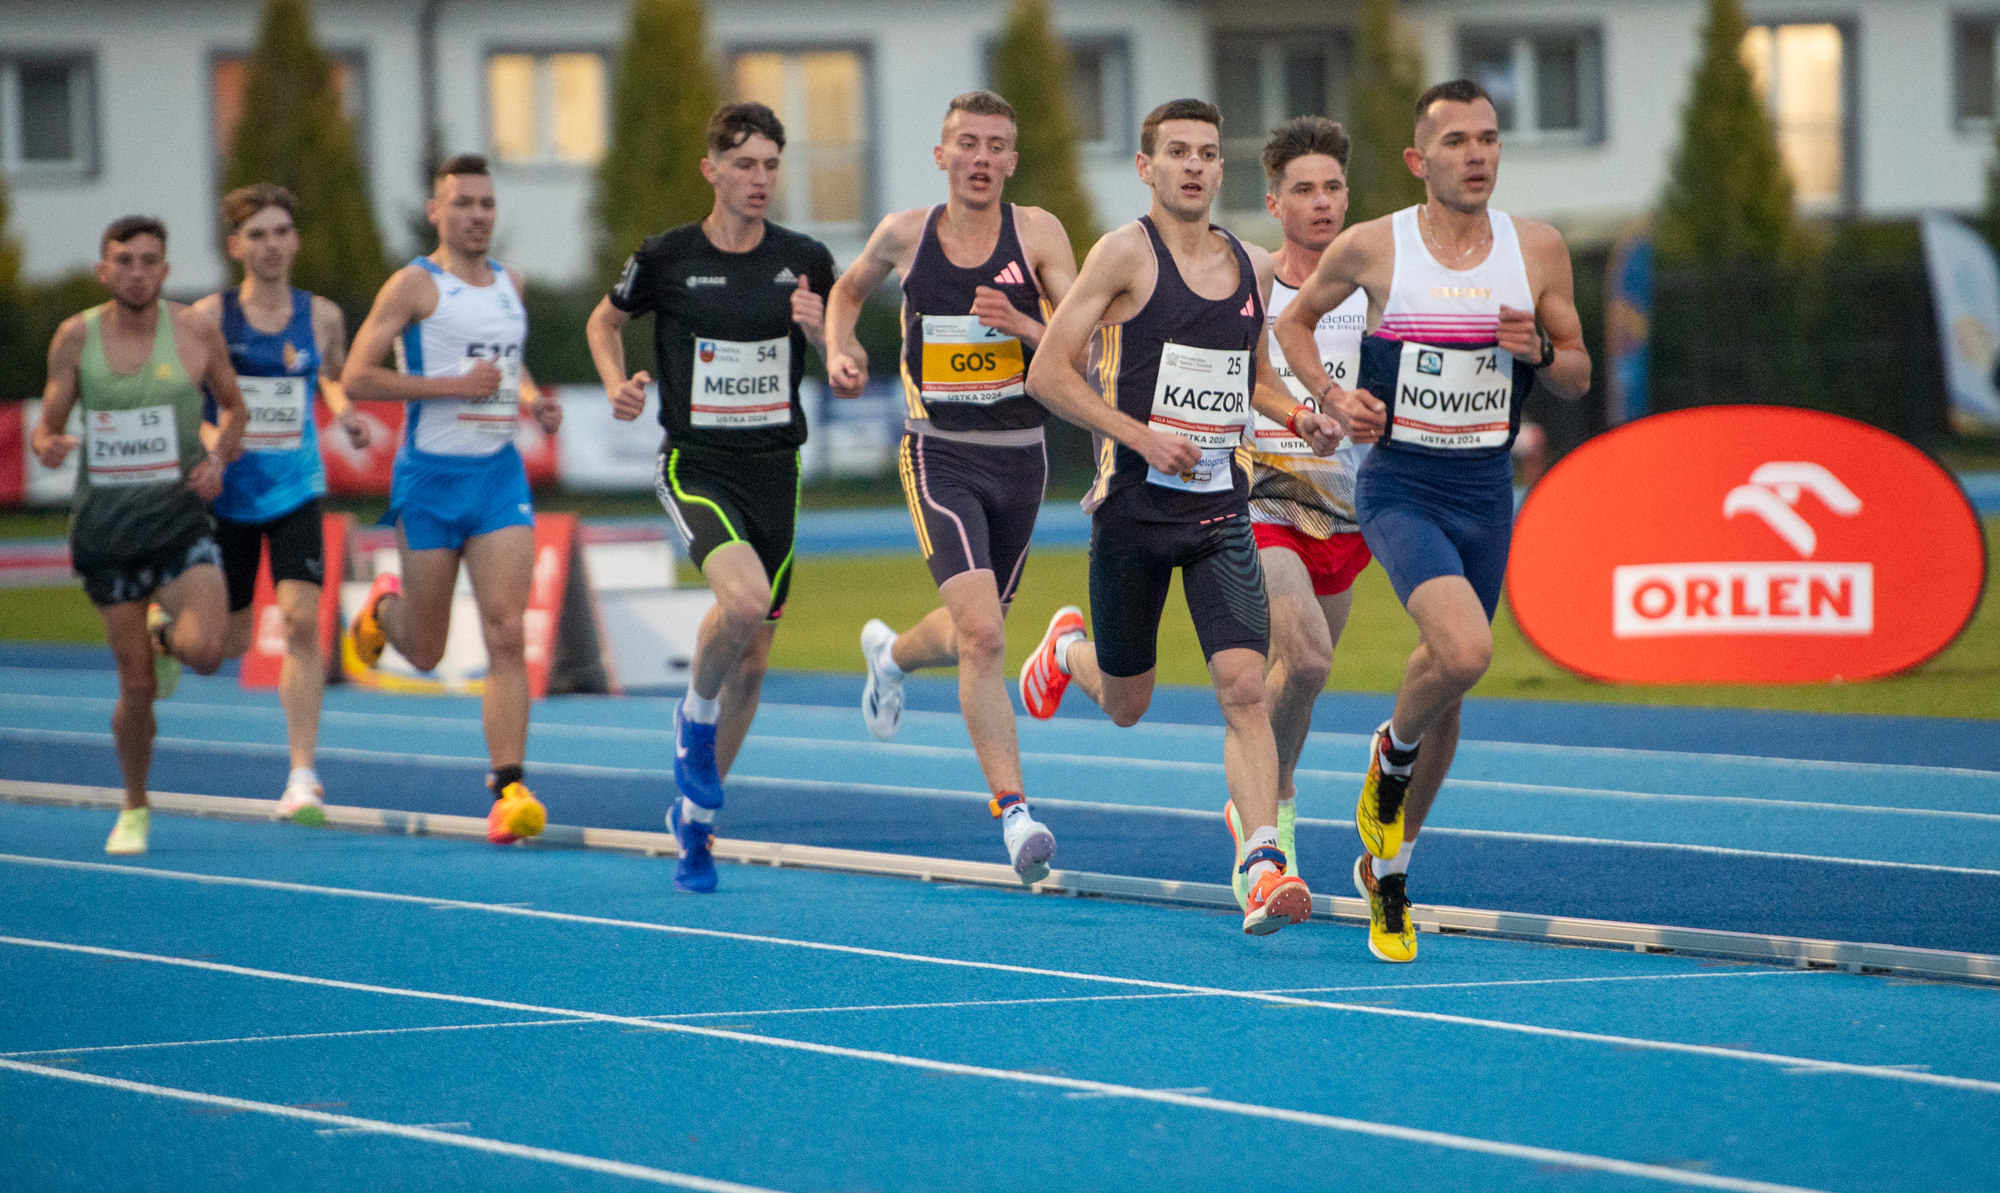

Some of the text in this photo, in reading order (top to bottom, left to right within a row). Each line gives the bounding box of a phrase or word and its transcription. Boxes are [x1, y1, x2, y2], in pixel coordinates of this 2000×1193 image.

[1319, 314, 1365, 324] adom
[757, 345, 777, 362] 54
[951, 352, 996, 372] GOS
[1227, 356, 1241, 375] 25
[1324, 361, 1346, 379] 26
[1475, 354, 1498, 375] 74
[705, 375, 780, 395] MEGIER
[980, 391, 1002, 400] 2024
[1163, 384, 1244, 413] KACZOR
[1401, 384, 1506, 412] NOWICKI
[141, 410, 158, 427] 15
[249, 407, 297, 422] TOSZ
[716, 415, 745, 423] USTKA
[1209, 436, 1226, 444] 2024
[1420, 434, 1481, 445] USTKA 2024
[1631, 576, 1854, 620] ORLEN
